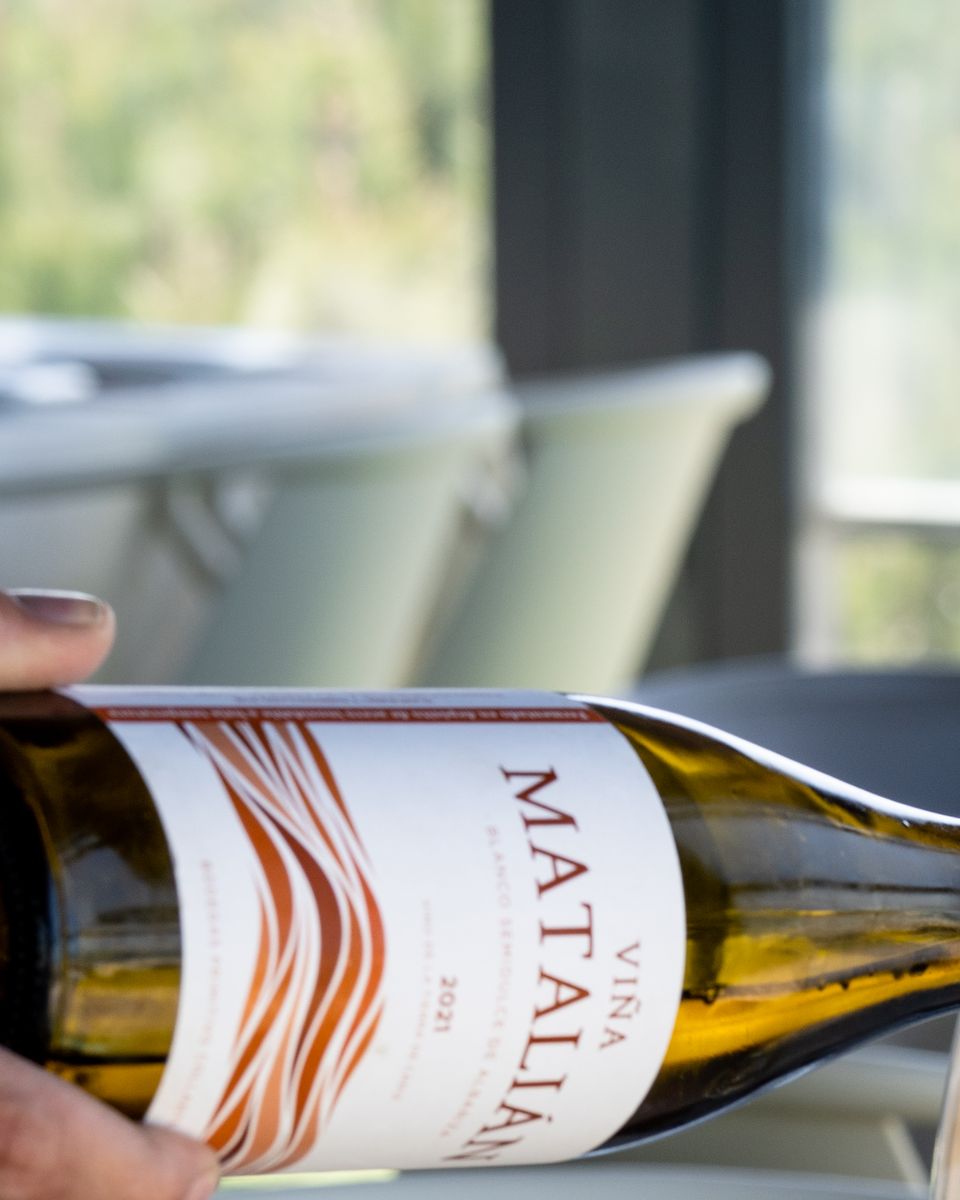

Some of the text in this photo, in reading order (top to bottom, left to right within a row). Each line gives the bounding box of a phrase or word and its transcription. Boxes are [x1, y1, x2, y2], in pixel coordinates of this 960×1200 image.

[433, 976, 457, 1034] 2021
[441, 765, 594, 1162] MATALIÁN
[600, 937, 641, 1051] VIÑA
